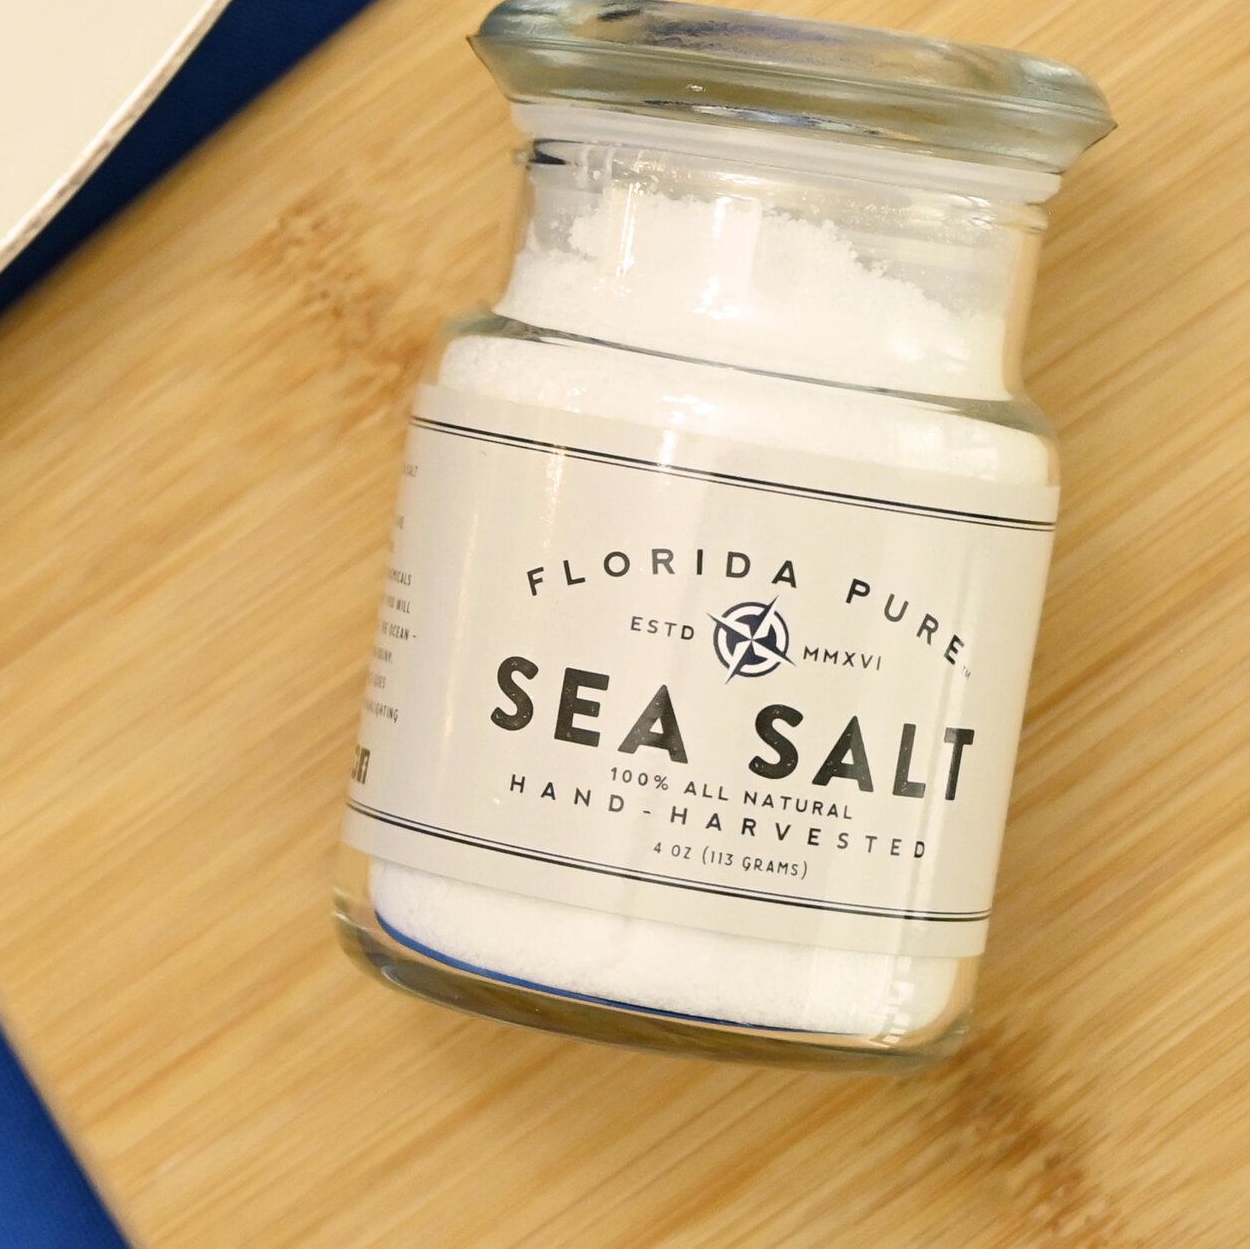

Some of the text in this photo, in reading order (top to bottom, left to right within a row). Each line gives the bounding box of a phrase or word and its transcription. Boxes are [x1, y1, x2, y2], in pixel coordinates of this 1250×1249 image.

[526, 548, 798, 596] FLORIDA
[845, 578, 965, 666] PURE
[630, 616, 882, 671] ESTD MMXVI
[490, 656, 976, 801] SEA SALT
[609, 766, 853, 820] 100% ALL NATURAL
[653, 841, 809, 880] 4 OZ (113 GRAMS)
